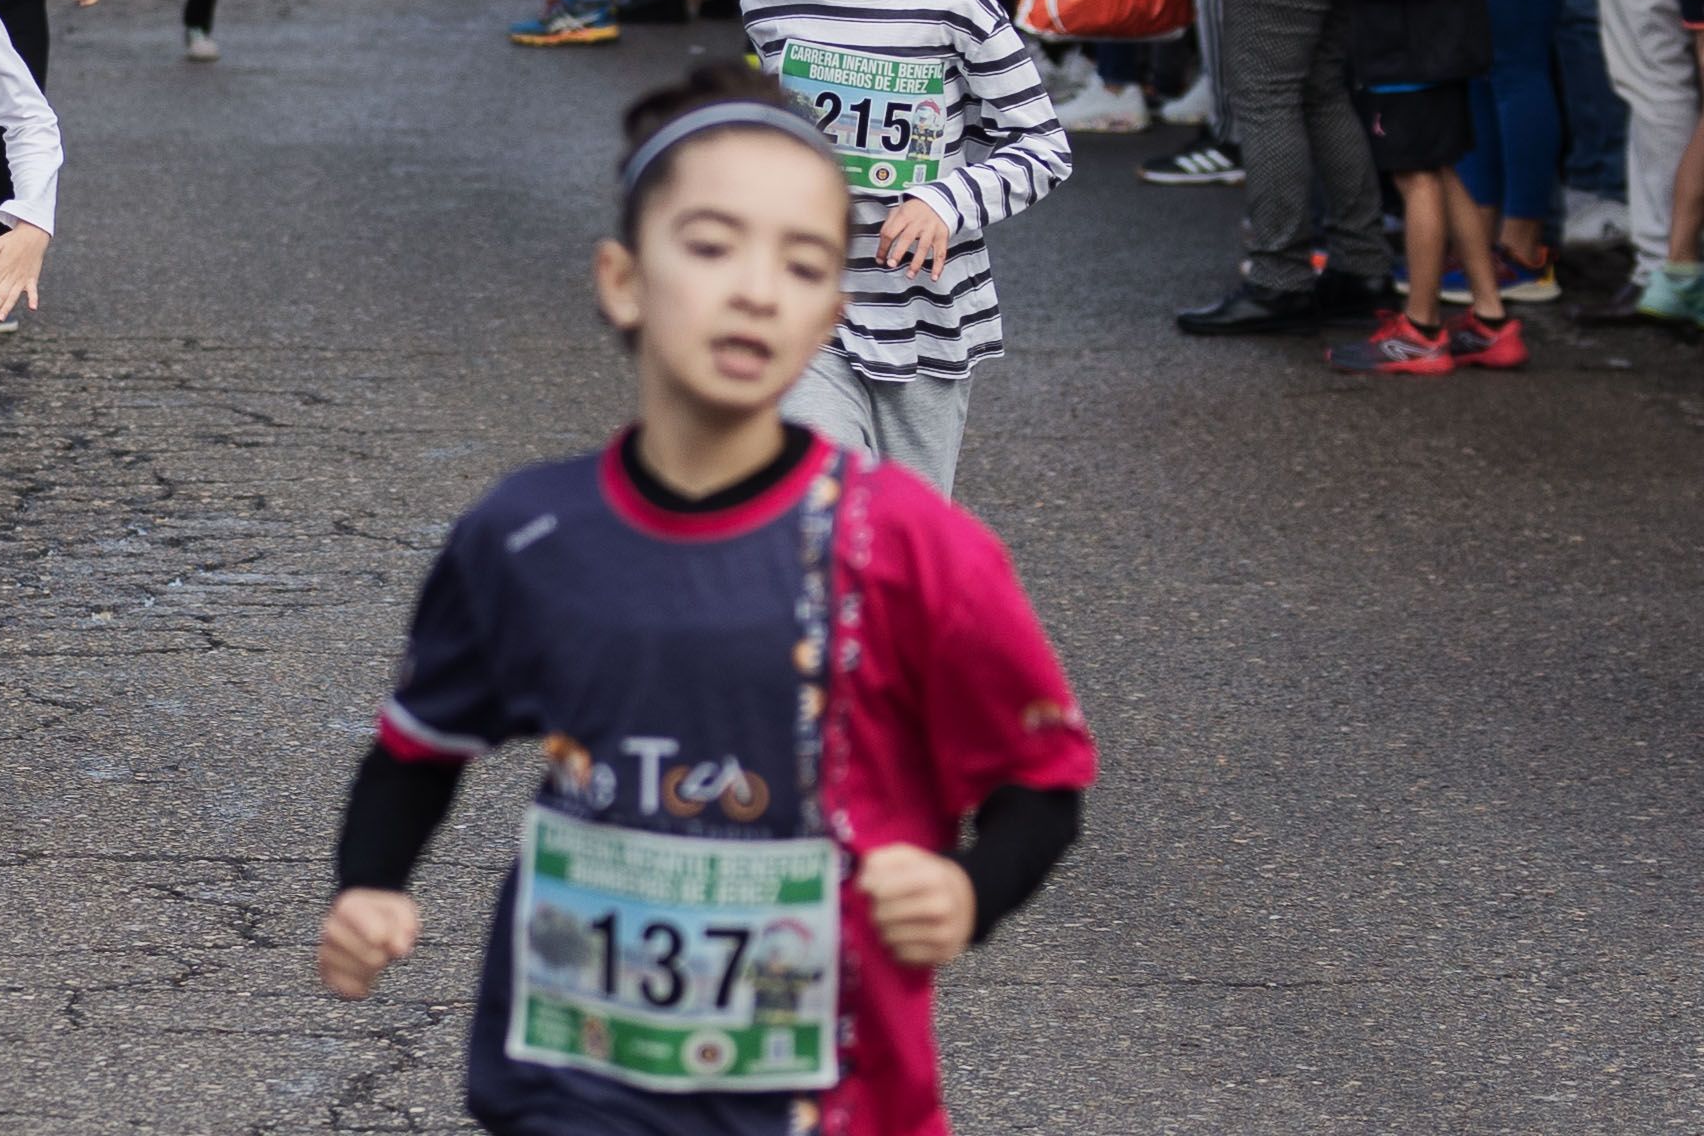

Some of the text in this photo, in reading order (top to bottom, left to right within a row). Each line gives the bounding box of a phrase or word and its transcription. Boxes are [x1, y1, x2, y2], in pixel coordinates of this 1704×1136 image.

[790, 45, 840, 68] CARRERA
[842, 54, 896, 77] INFANTIL
[809, 64, 929, 94] BOMBEROS DE JEREZ
[814, 91, 913, 152] 215
[593, 910, 753, 1008] 137
